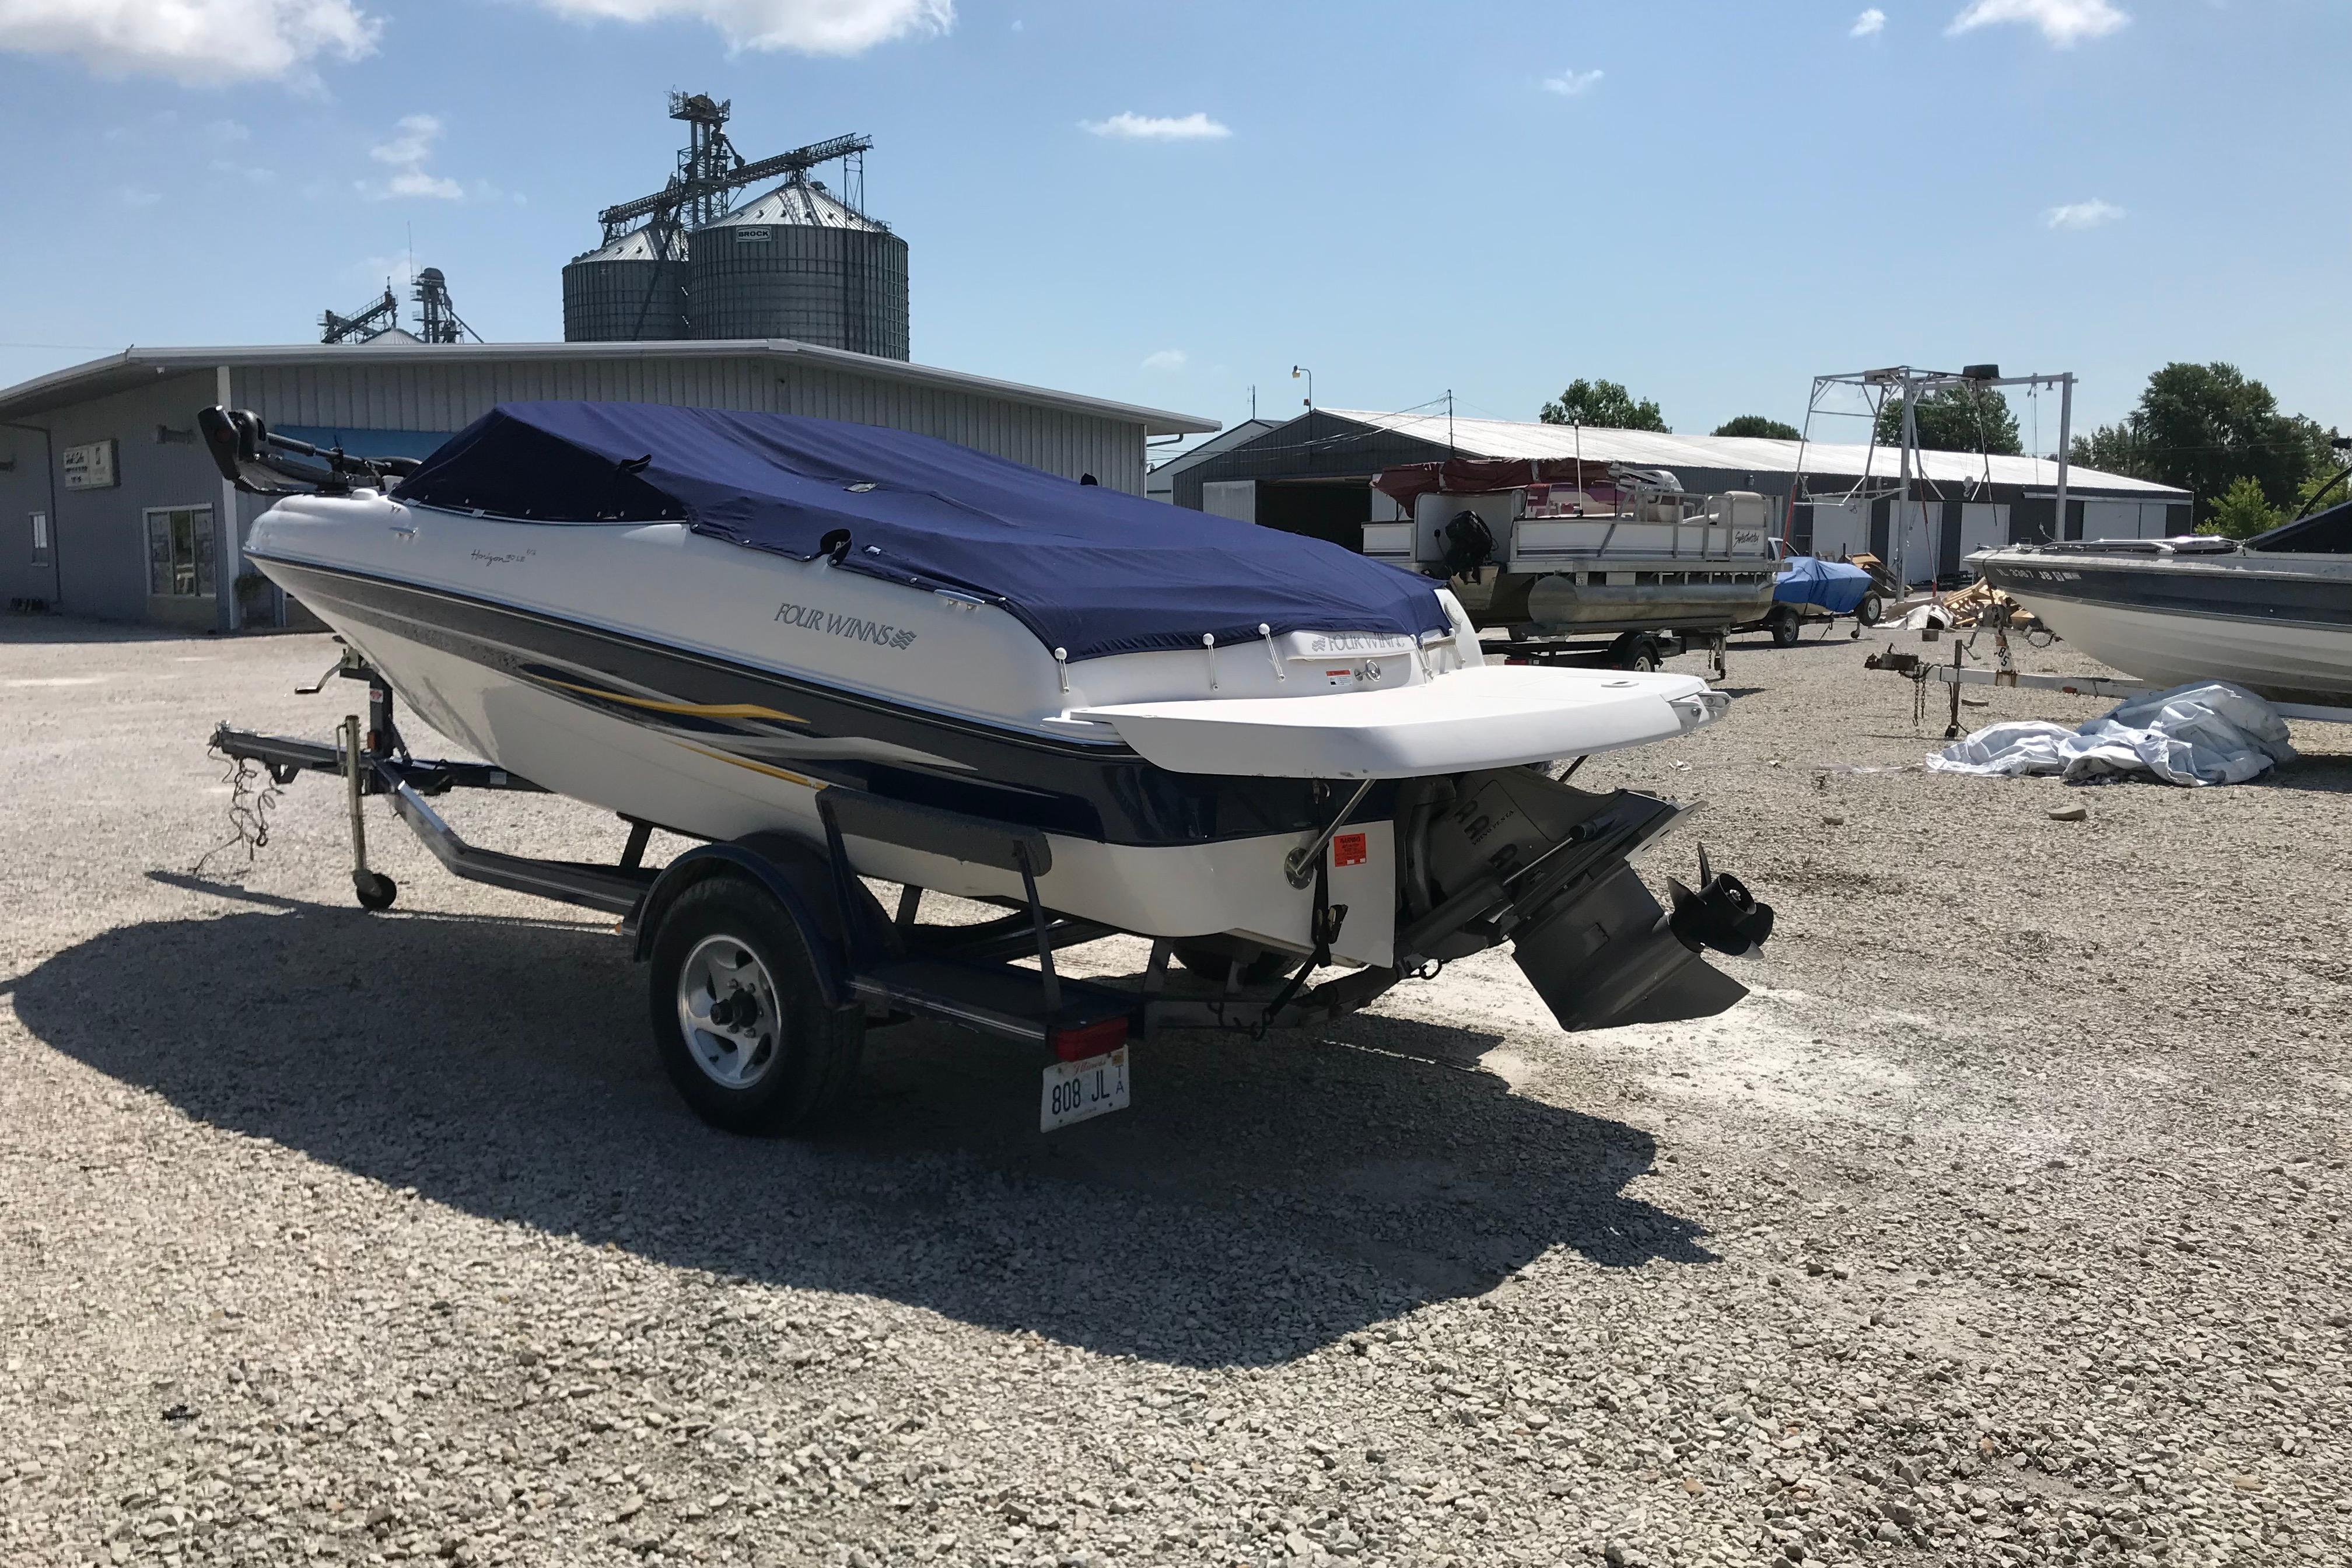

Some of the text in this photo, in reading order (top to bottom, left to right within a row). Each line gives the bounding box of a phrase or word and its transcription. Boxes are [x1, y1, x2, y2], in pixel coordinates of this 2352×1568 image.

[471, 549, 510, 567] Horizon
[1996, 568, 2009, 576] IL
[774, 603, 894, 645] FOUR WINNS
[1472, 810, 1514, 845] VOLVO PENTA
[1052, 1069, 1110, 1115] 808 JL
